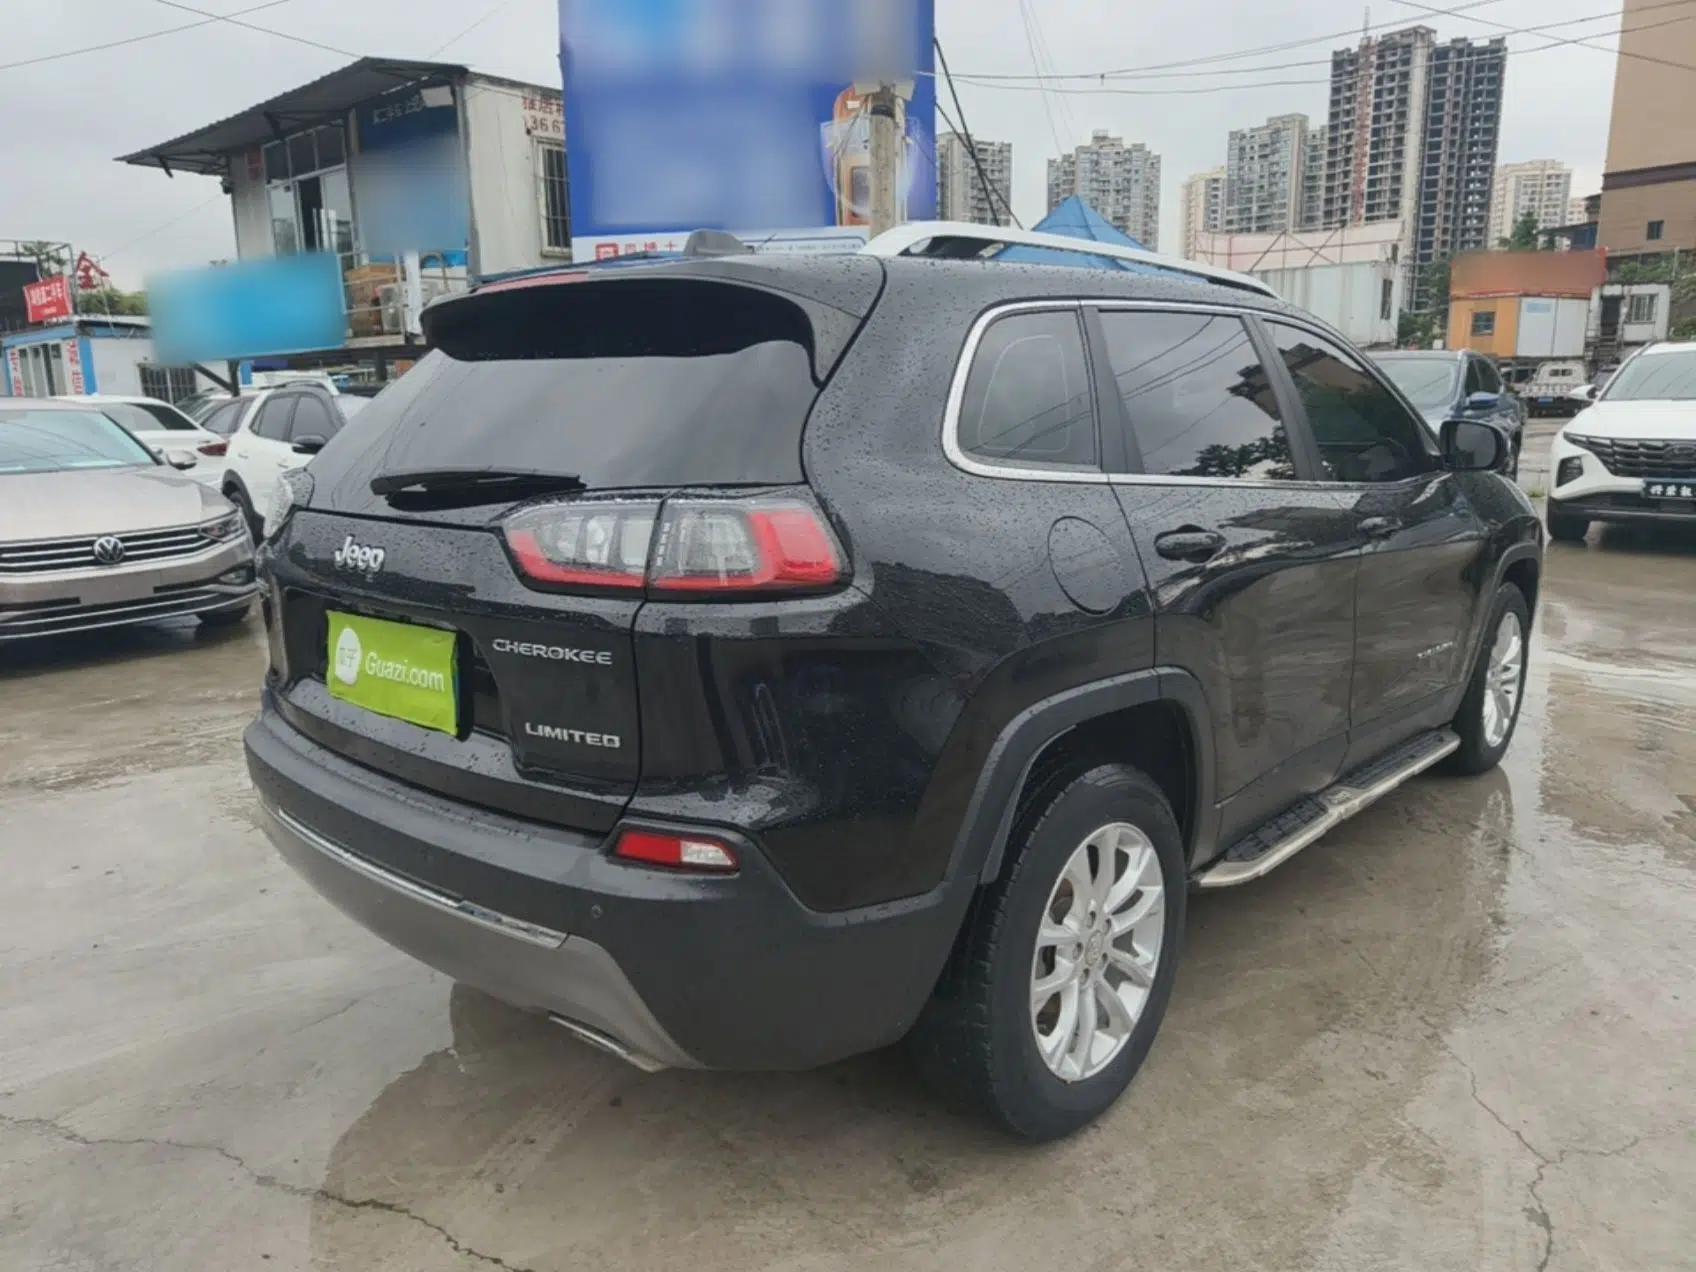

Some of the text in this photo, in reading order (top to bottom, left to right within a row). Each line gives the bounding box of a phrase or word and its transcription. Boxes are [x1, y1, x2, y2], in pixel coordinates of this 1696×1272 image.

[334, 534, 386, 572] Jeep
[491, 637, 613, 666] CHEROKEE
[366, 651, 445, 693] Guazi.com
[524, 721, 622, 749] LIMITED
